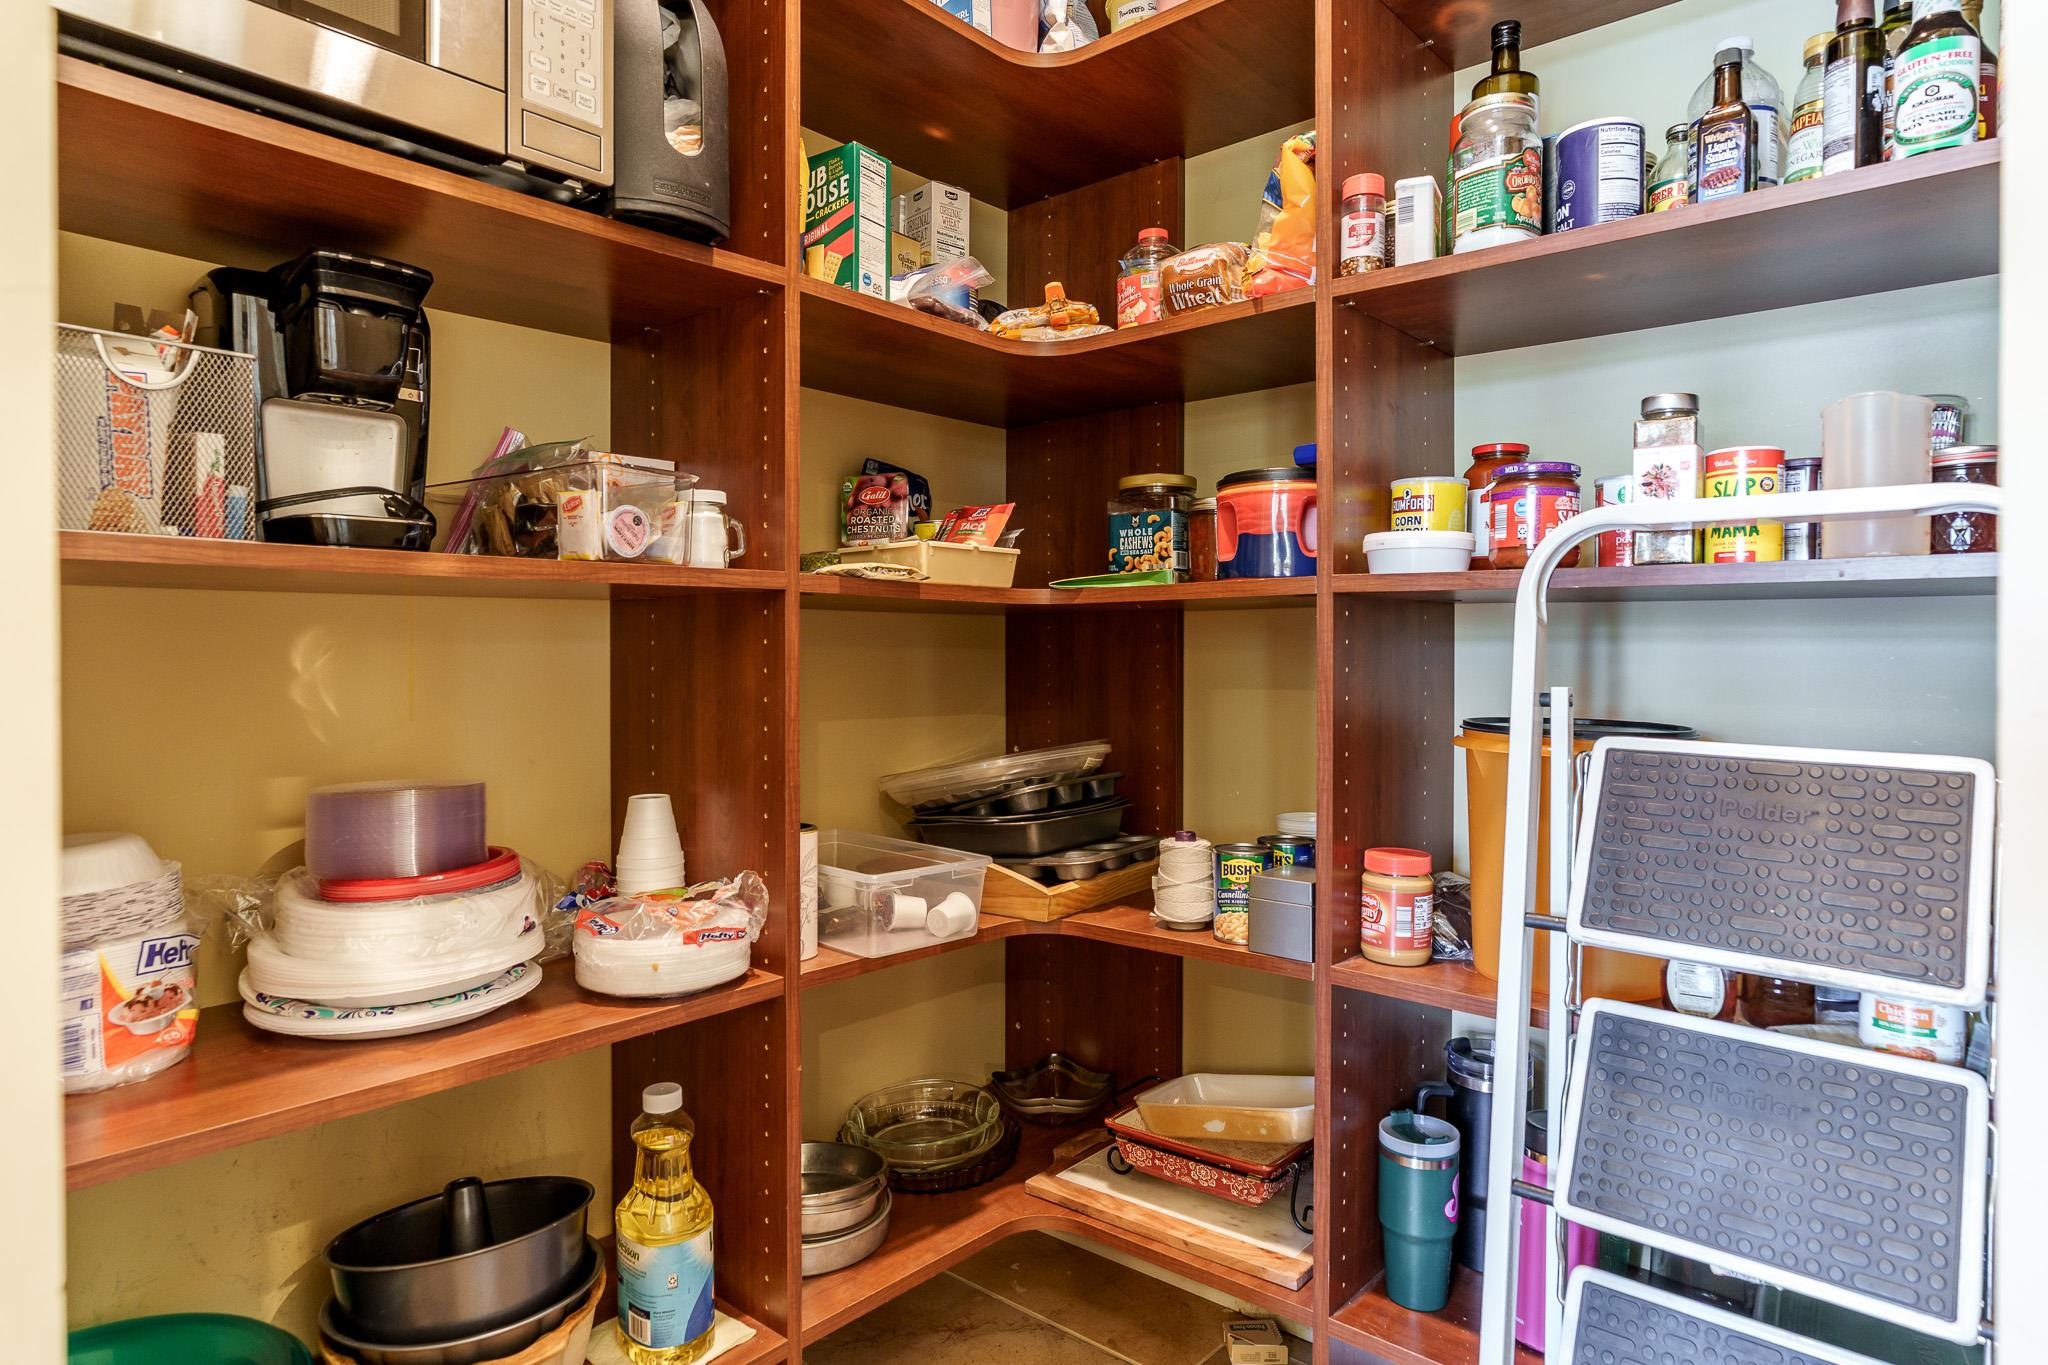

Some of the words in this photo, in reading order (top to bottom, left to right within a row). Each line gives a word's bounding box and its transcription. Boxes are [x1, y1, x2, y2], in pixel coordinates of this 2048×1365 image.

[1897, 51, 1975, 77] GLUTEN-FREE
[1707, 138, 1737, 154] Liquid
[1705, 149, 1738, 165] Smoke
[807, 165, 827, 193] UB
[806, 173, 850, 215] OUSE
[1651, 187, 1673, 204] BRER
[815, 196, 849, 219] CRACKERS
[940, 204, 963, 221] ORIGINAL
[942, 216, 961, 230] WHEAT
[804, 222, 829, 246] RIGINAL
[898, 254, 917, 266] Gluten
[902, 262, 914, 271] Free
[1168, 280, 1194, 293] Whole
[1196, 274, 1222, 288] Grain
[1171, 286, 1223, 311] Wheat
[1504, 465, 1519, 474] MILD
[861, 490, 887, 500] Galil
[853, 508, 895, 516] ORGANIC
[850, 515, 895, 525] ROASTED
[960, 522, 987, 531] TACO
[1395, 515, 1422, 527] CORN
[847, 525, 901, 535] CHESTNUTS
[1119, 527, 1153, 537] WHOLE
[1710, 525, 1760, 539] MAMA
[1119, 536, 1153, 550] CASHEWS
[1719, 798, 1808, 825] Polder
[1223, 864, 1261, 876] BUSH'S
